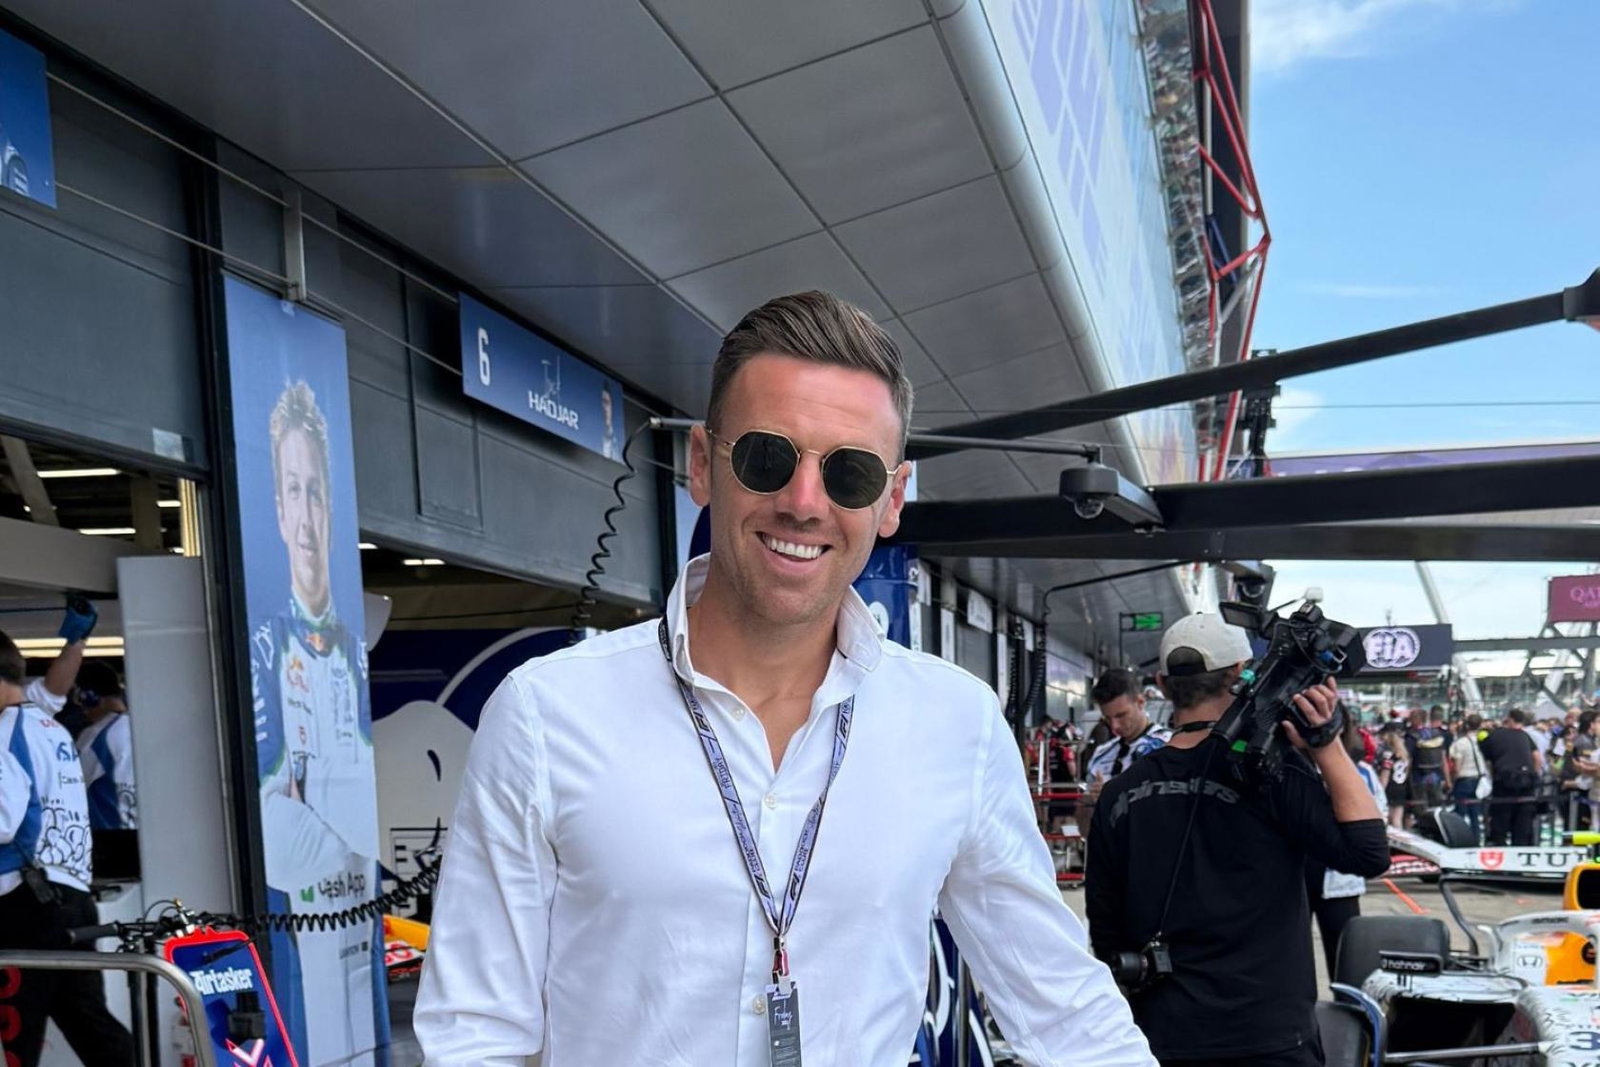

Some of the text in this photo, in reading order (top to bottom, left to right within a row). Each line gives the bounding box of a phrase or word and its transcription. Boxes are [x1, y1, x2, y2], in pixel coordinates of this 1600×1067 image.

[477, 327, 491, 386] 6
[528, 390, 579, 430] HADJAR
[1368, 635, 1413, 660] FIA
[713, 756, 732, 790] FRIDAY
